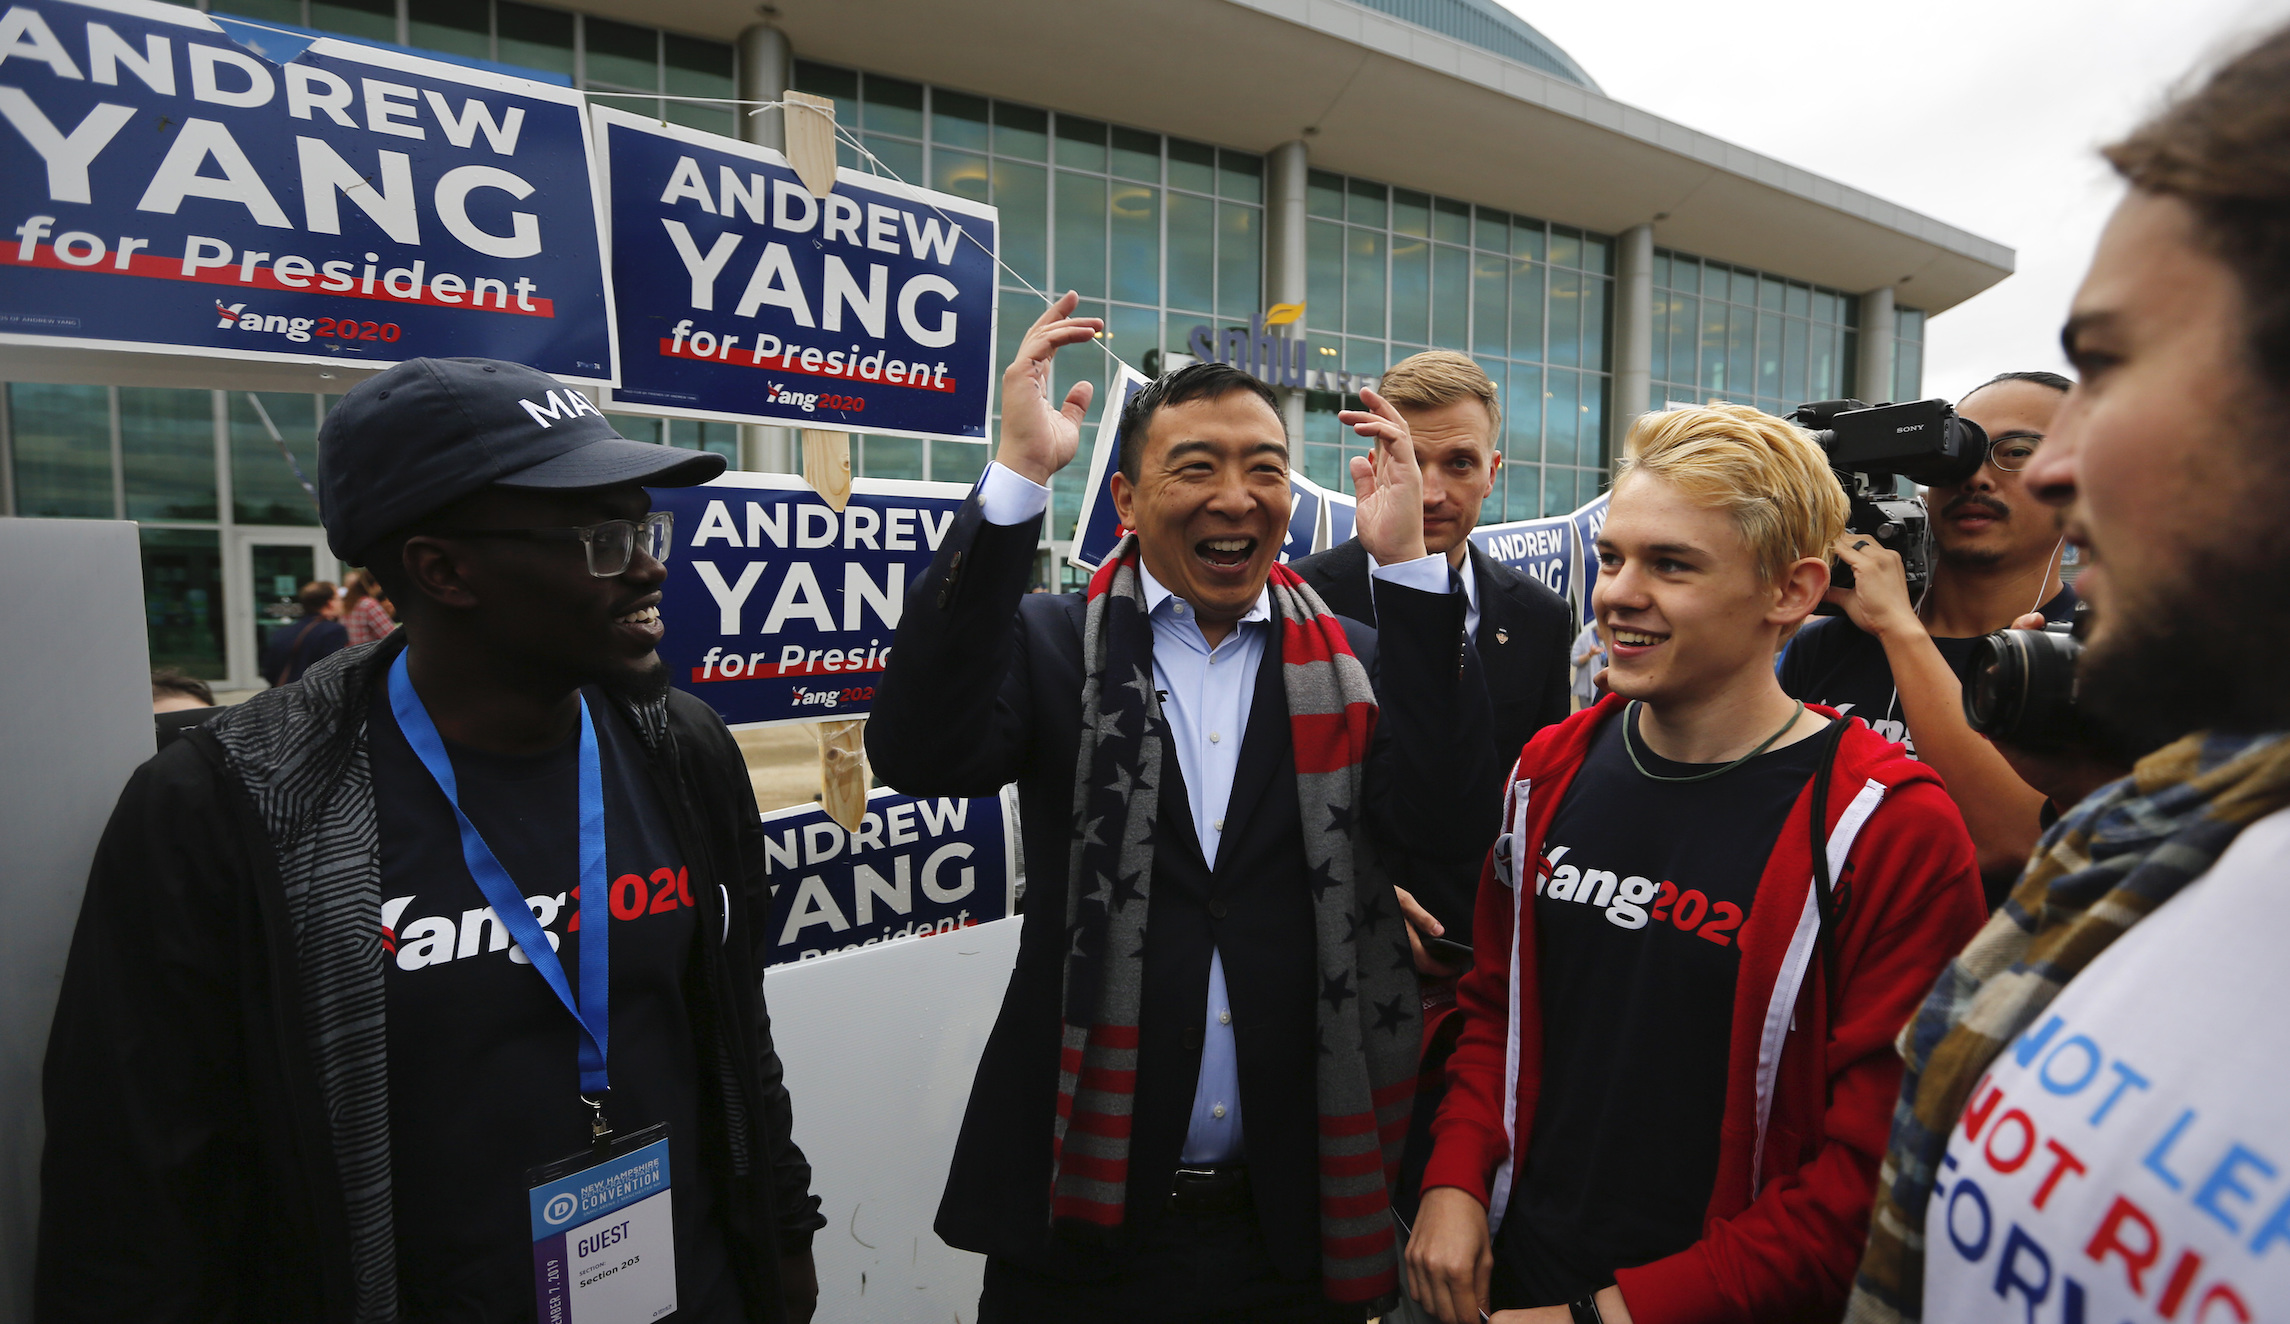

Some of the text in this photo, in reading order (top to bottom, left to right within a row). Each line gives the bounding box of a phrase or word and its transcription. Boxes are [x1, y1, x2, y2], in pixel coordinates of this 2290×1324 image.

[0, 6, 526, 157] ANDREW
[0, 86, 543, 259] YANG
[660, 155, 962, 266] ANDREW
[16, 216, 538, 313] for President
[660, 218, 960, 349] YANG
[671, 319, 951, 389] for President
[1314, 367, 1383, 395] ARE
[1896, 423, 1925, 434] SONY
[1488, 527, 1563, 562] ANDREW
[691, 560, 906, 636] YAN
[702, 646, 765, 680] for
[791, 685, 876, 708] Yang202
[764, 796, 969, 876] NDREW
[770, 841, 976, 947] ANG
[581, 1157, 660, 1195] NEW HAMPSHIRE
[582, 1169, 660, 1211] CONVENTION
[577, 1220, 630, 1259] GUEST
[547, 1260, 559, 1282] 2019
[579, 1261, 607, 1277] SECTION:
[579, 1255, 640, 1289] Section 203
